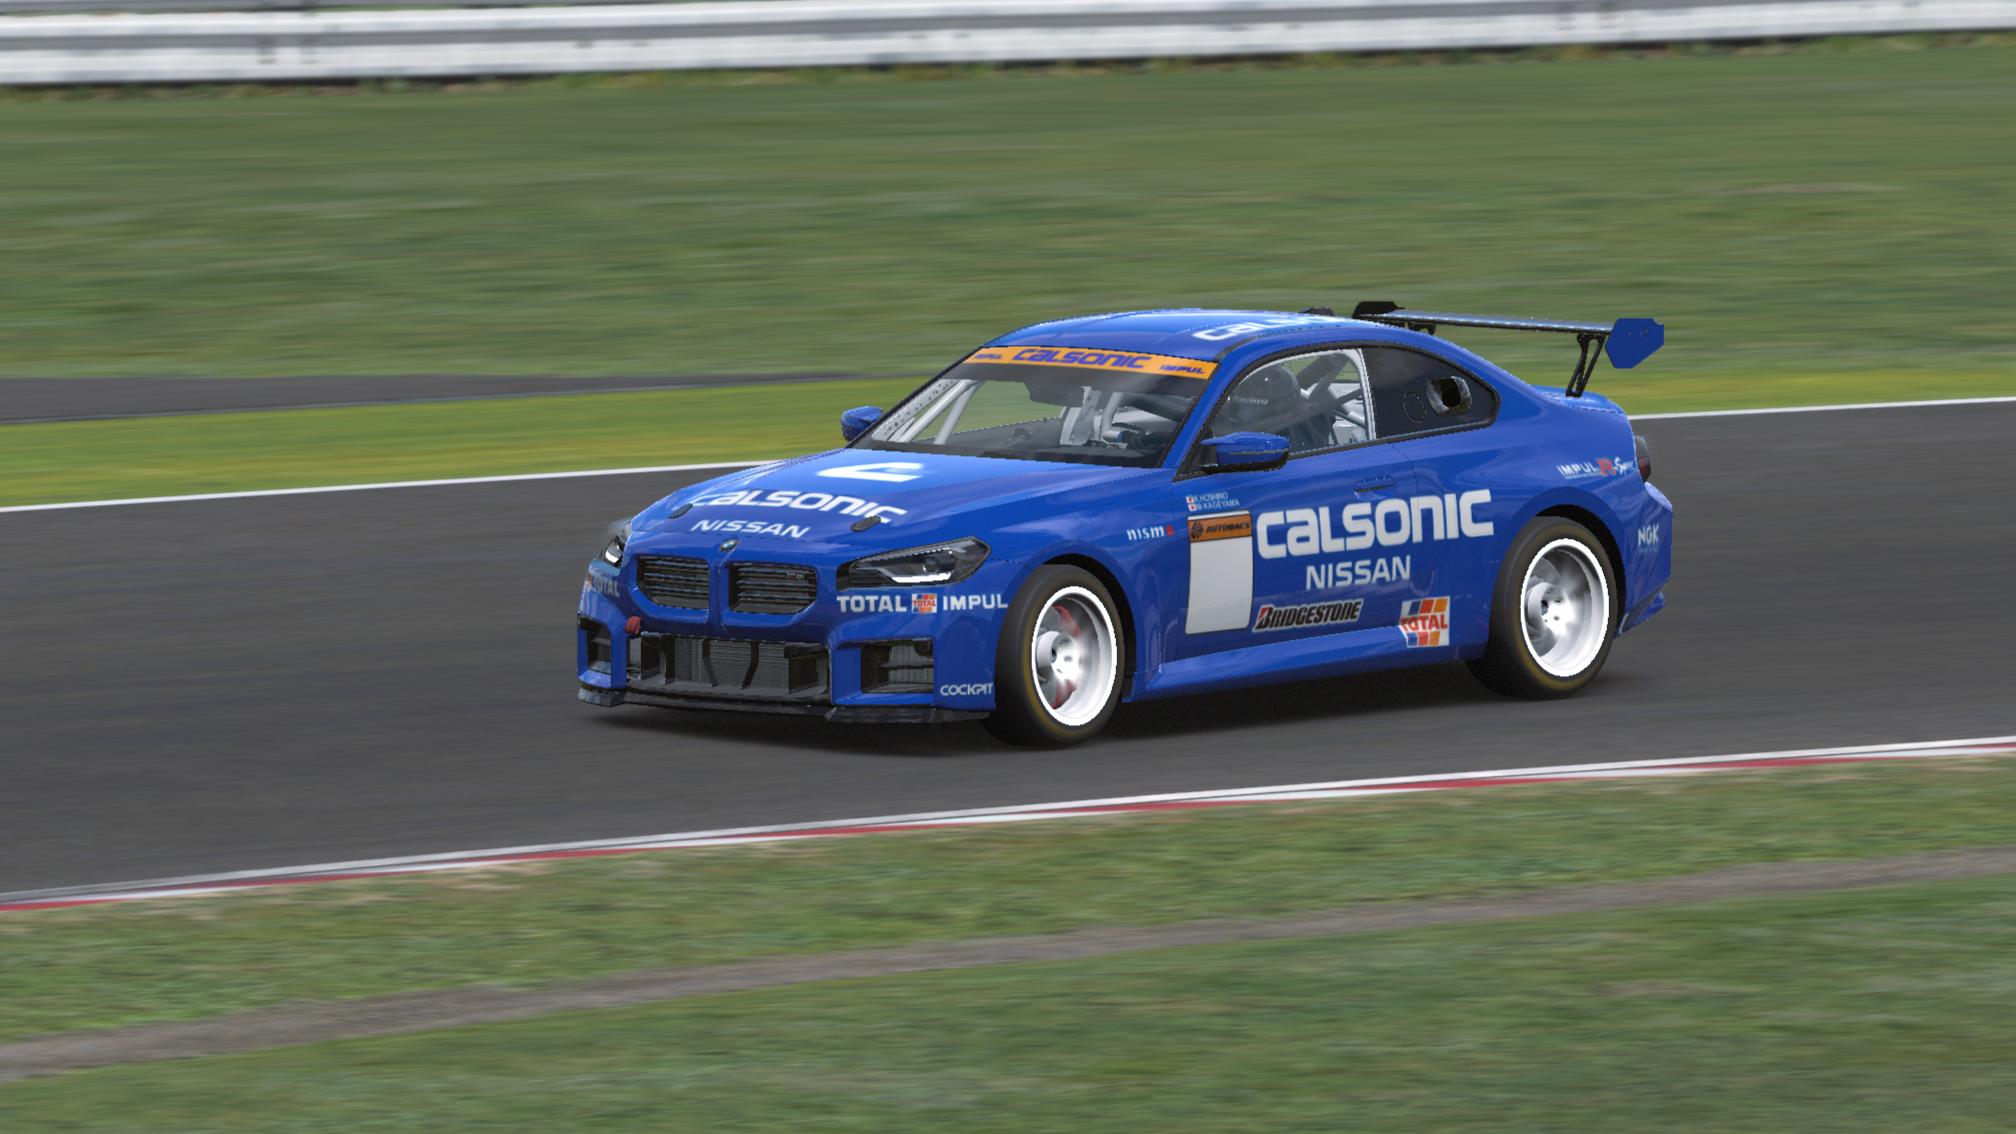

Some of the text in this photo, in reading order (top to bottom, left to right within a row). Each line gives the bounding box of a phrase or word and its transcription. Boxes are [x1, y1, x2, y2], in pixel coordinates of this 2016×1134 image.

[1557, 462, 1597, 475] IMPUL
[690, 519, 811, 538] NISSAN
[1206, 522, 1250, 533] AUTOBACS
[1638, 523, 1659, 546] NGK
[1306, 555, 1411, 591] NISSAN
[836, 595, 907, 613] TOTAL
[943, 593, 1008, 610] IMPUL
[1400, 614, 1449, 633] TOTAL
[940, 683, 994, 696] COCKPIT
